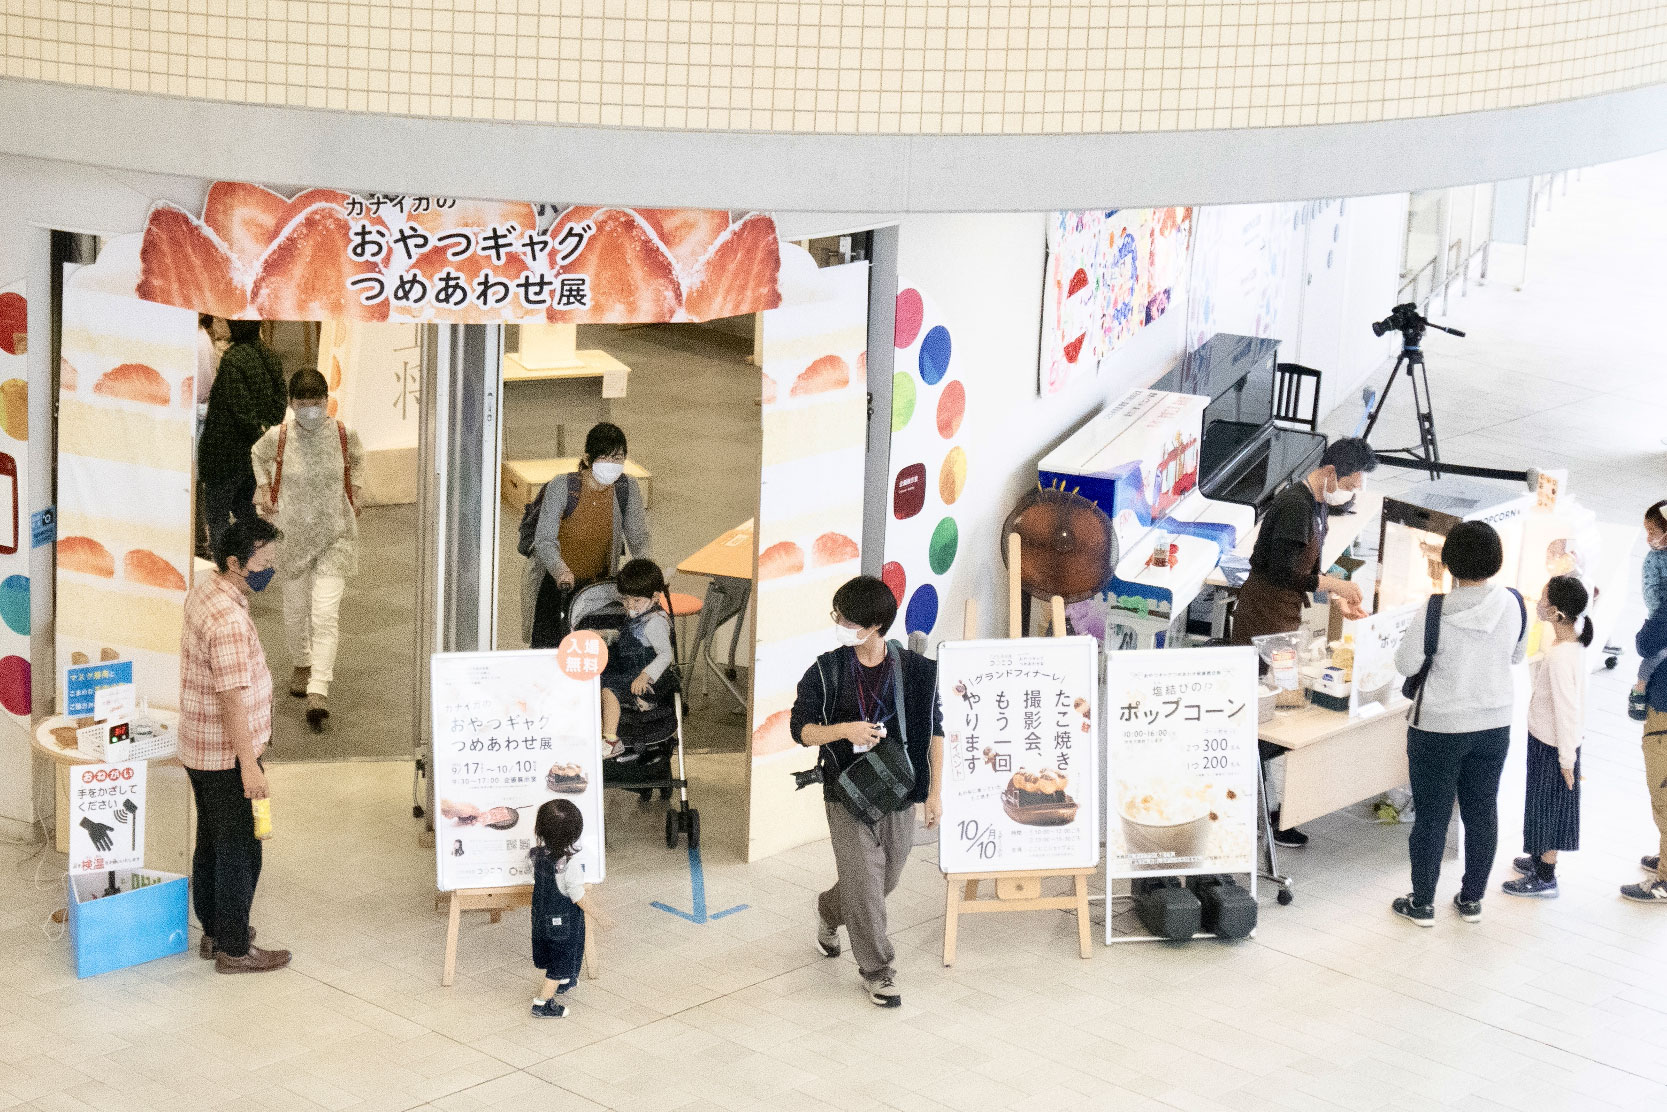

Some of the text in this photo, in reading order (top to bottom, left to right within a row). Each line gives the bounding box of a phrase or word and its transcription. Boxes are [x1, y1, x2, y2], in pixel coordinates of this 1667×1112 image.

[351, 224, 593, 262] おやつギャグ
[350, 271, 588, 307] つめあわせ展
[567, 639, 599, 655] 入場
[566, 656, 598, 672] 無料
[974, 669, 1060, 684] グランドフィナーレ
[1119, 697, 1246, 725] ポップコーン
[1023, 689, 1042, 757] 撮影会、
[1054, 689, 1072, 771] たこ焼き
[964, 692, 981, 774] やります
[994, 691, 1012, 772] もう一回
[451, 736, 553, 752] つめあわせ展
[1202, 738, 1228, 752] 300
[1202, 755, 1228, 770] 200
[77, 785, 138, 799] 手をかざして
[78, 800, 118, 812] ください
